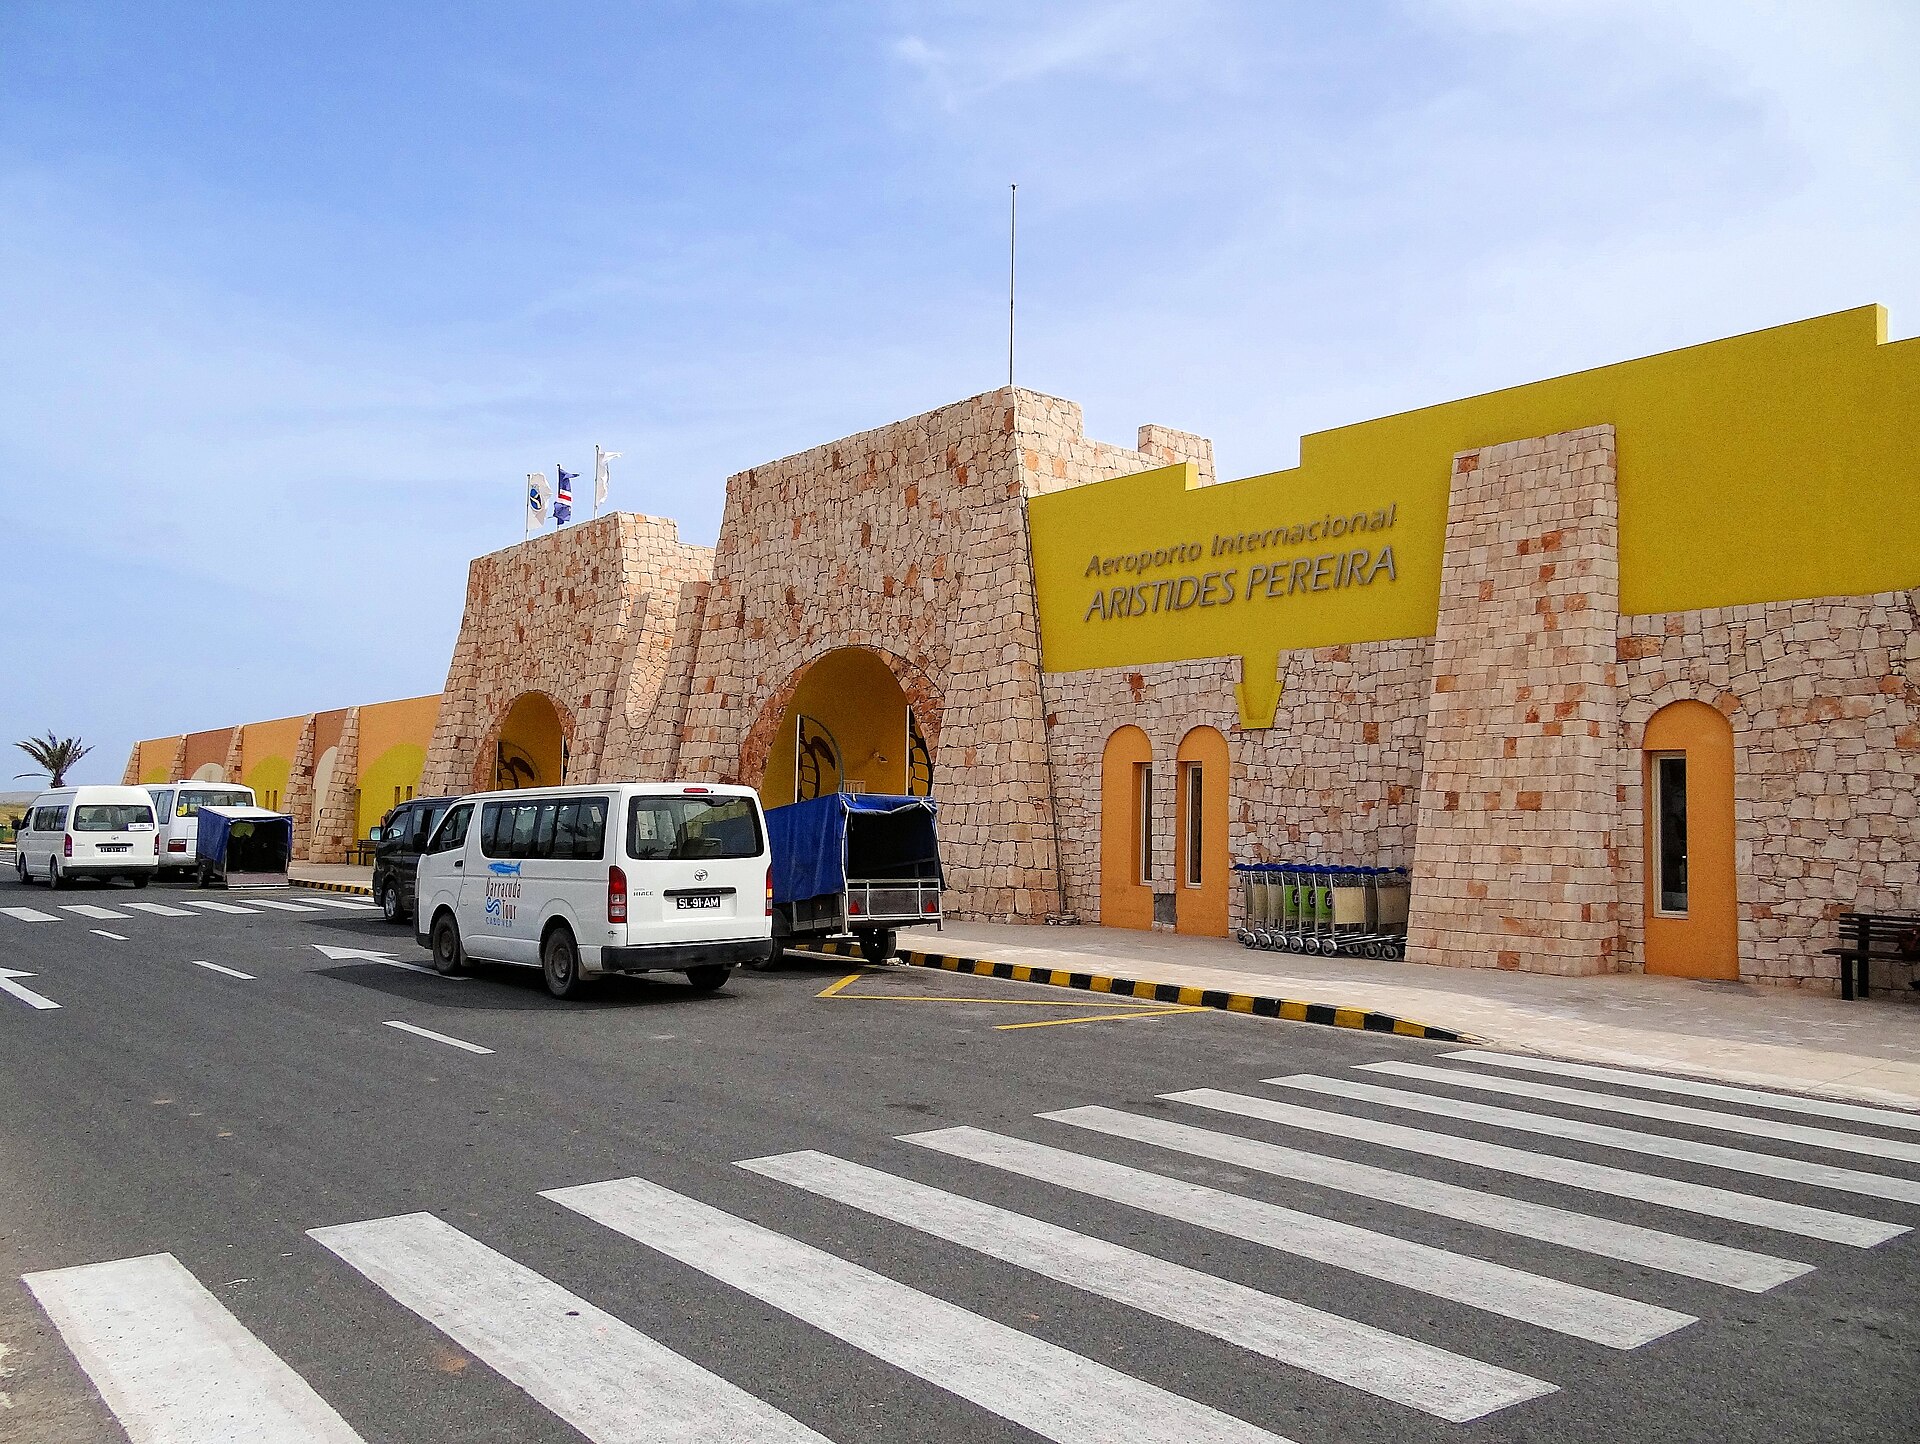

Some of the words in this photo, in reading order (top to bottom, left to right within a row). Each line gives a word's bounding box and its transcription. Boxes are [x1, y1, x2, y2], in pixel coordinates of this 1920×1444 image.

[1083, 539, 1202, 578] Aeroporto
[1210, 501, 1398, 556] Internacional
[1083, 568, 1238, 622] ARISTIDES
[1245, 543, 1397, 601] PEREIRA
[502, 899, 517, 920] Tour
